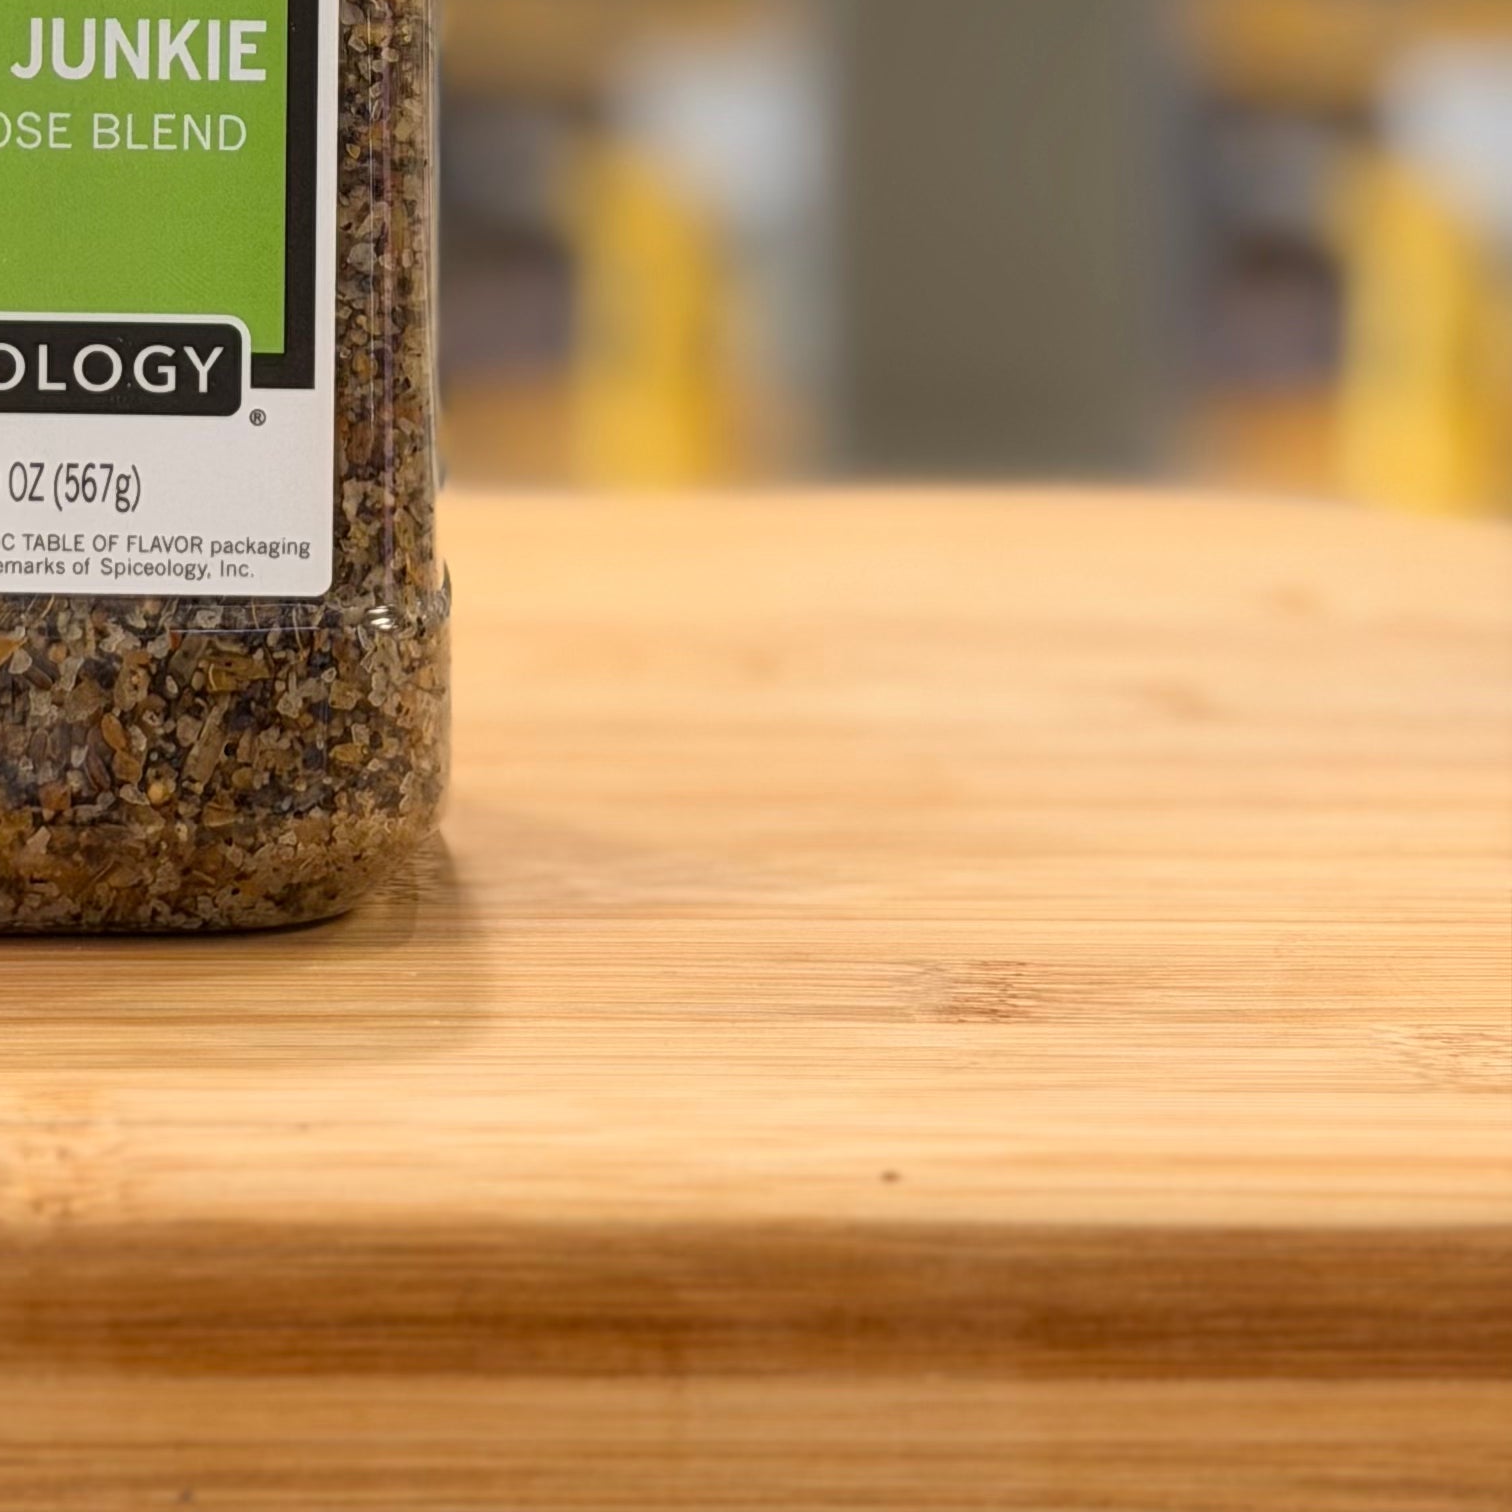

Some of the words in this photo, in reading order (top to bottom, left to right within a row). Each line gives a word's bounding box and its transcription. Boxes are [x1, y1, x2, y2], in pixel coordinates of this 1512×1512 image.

[10, 17, 267, 81] JUNKIE
[92, 113, 246, 151] BLEND
[9, 462, 45, 502] OZ
[53, 462, 142, 512] (567g)
[21, 533, 84, 552] TABLE
[92, 535, 119, 553] OF
[126, 535, 204, 554] FLAVOR
[210, 536, 311, 558] packaging
[71, 556, 91, 576] of
[100, 557, 212, 580] Spiceology,
[218, 560, 254, 578] Inc.
